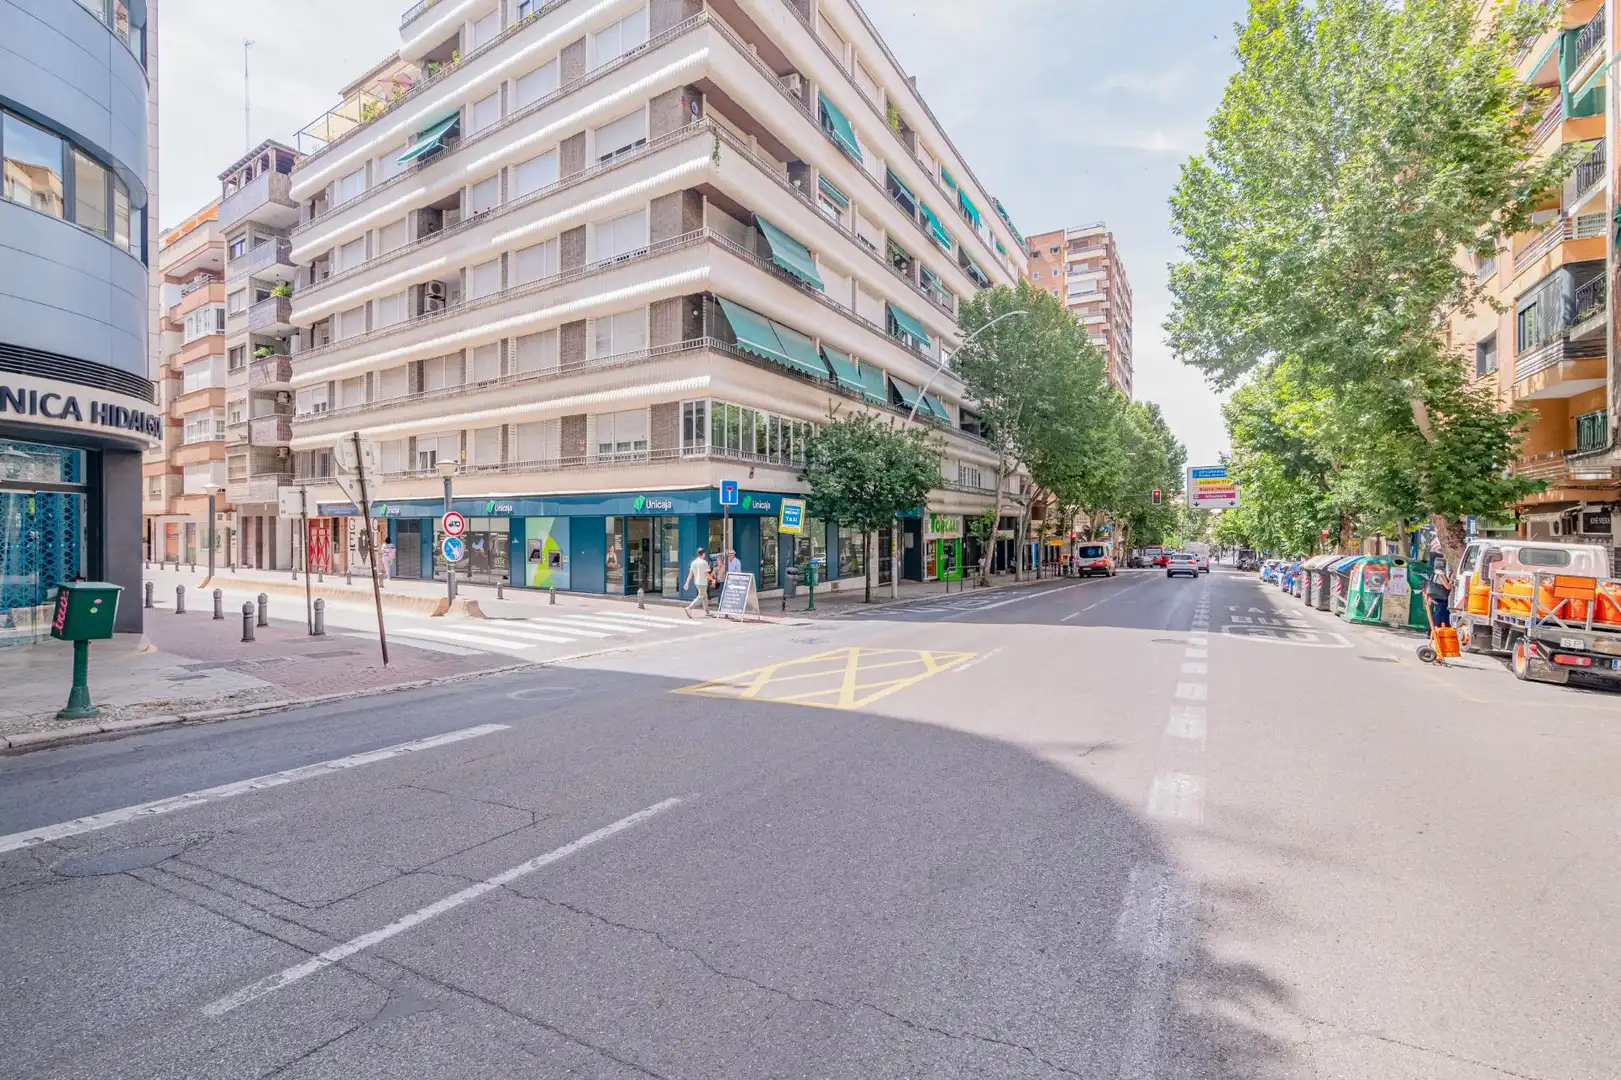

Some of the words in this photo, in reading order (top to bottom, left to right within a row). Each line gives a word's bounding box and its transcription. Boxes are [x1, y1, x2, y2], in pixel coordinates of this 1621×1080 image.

[494, 503, 513, 513] Unicaja
[646, 499, 672, 511] Unicaja
[752, 500, 771, 511] Unicaja
[1230, 615, 1312, 628] BUS
